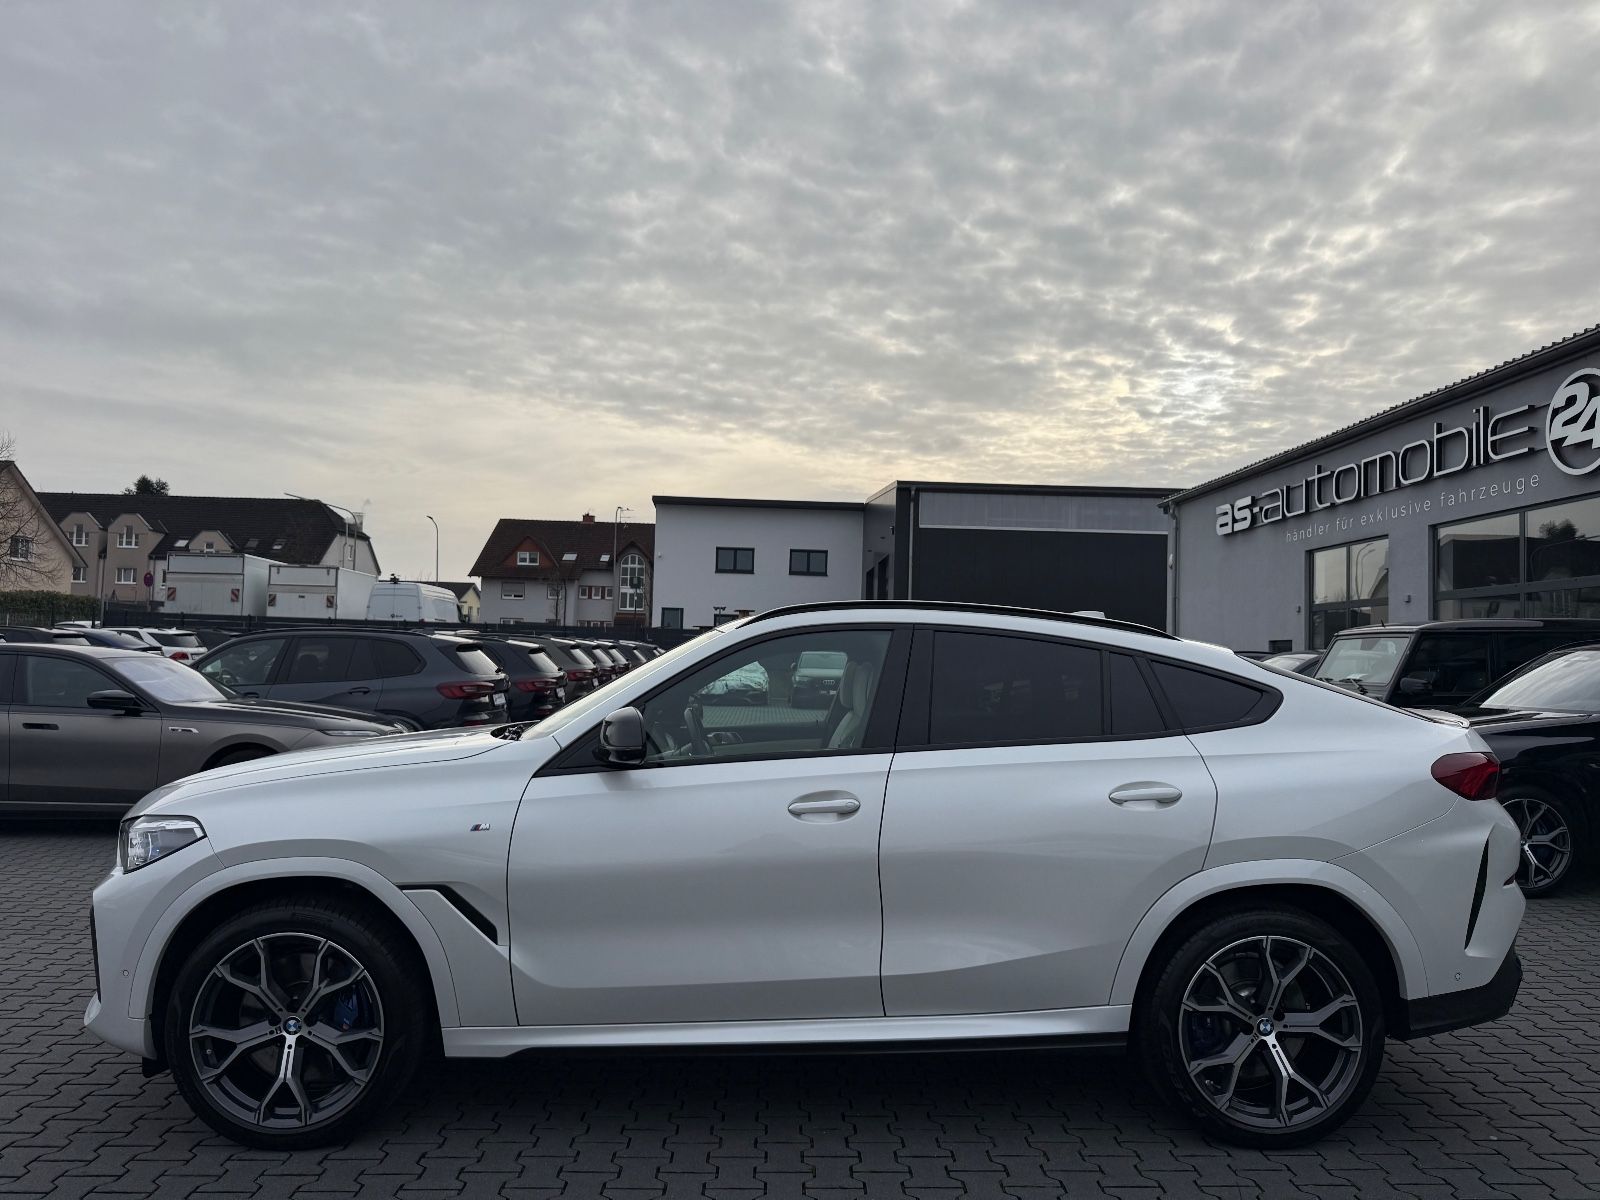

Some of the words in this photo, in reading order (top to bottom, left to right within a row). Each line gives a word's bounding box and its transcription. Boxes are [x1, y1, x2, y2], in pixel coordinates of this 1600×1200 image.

[1549, 382, 1600, 450] 24
[1286, 524, 1330, 543] händler
[1336, 516, 1354, 532] für
[1360, 499, 1431, 526] exklusive
[1440, 474, 1540, 508] fahrzeuge
